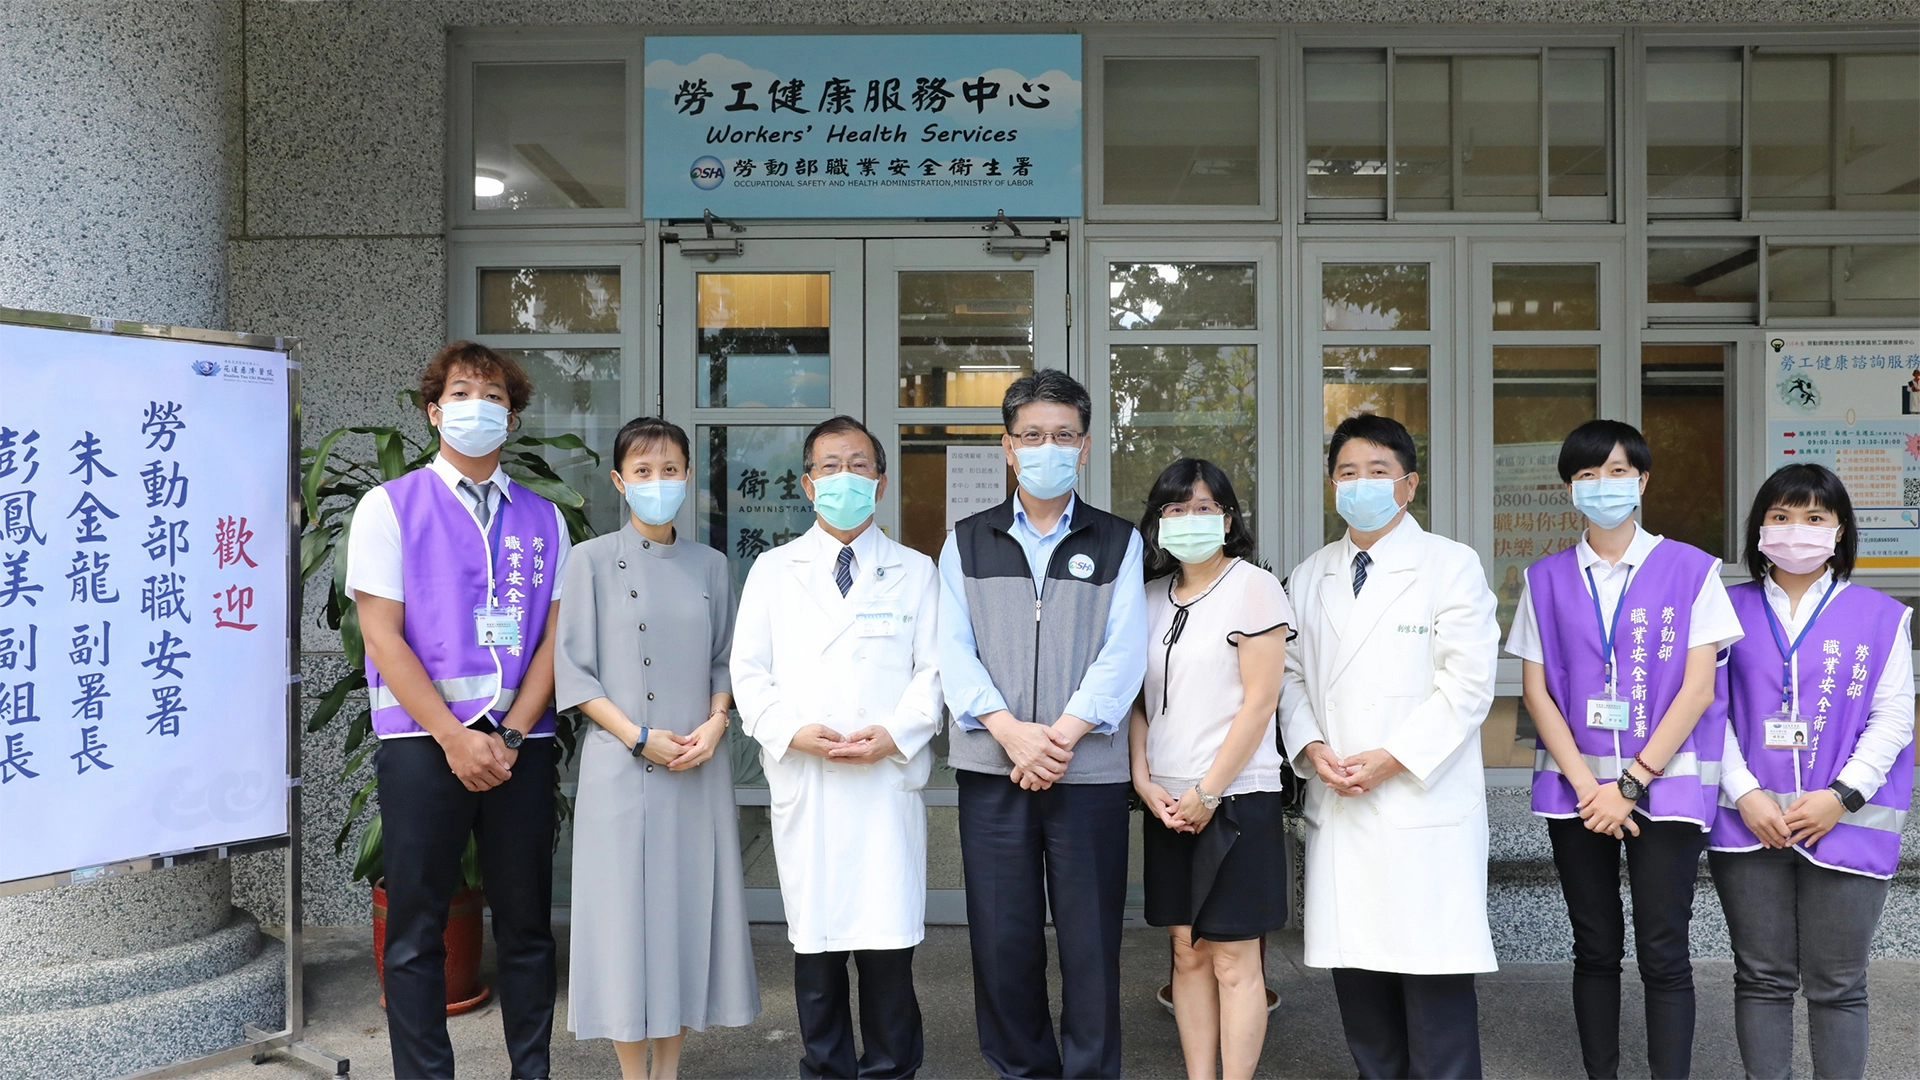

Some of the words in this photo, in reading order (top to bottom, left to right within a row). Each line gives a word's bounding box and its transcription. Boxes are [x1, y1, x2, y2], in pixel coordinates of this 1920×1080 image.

[674, 76, 1051, 116] 勞工健康服務中心
[826, 123, 908, 143] Health
[920, 123, 1018, 143] Services
[690, 167, 725, 179] OSHA
[733, 157, 1033, 177] 勞動部職業安全衛生署
[733, 180, 795, 188] OCCUPATIONAL
[1781, 353, 1920, 372] 勞工健康諮詢服務
[737, 468, 801, 501] 衛生
[1494, 491, 1573, 507] 0800-068
[138, 400, 192, 738] 勞動部職安署
[211, 515, 259, 632] 歡迎
[504, 535, 526, 657] 職業安全衛署
[1657, 606, 1676, 662] 勞動部
[1630, 607, 1649, 739] 職業安全衛生署
[1846, 643, 1870, 700] 勞動部
